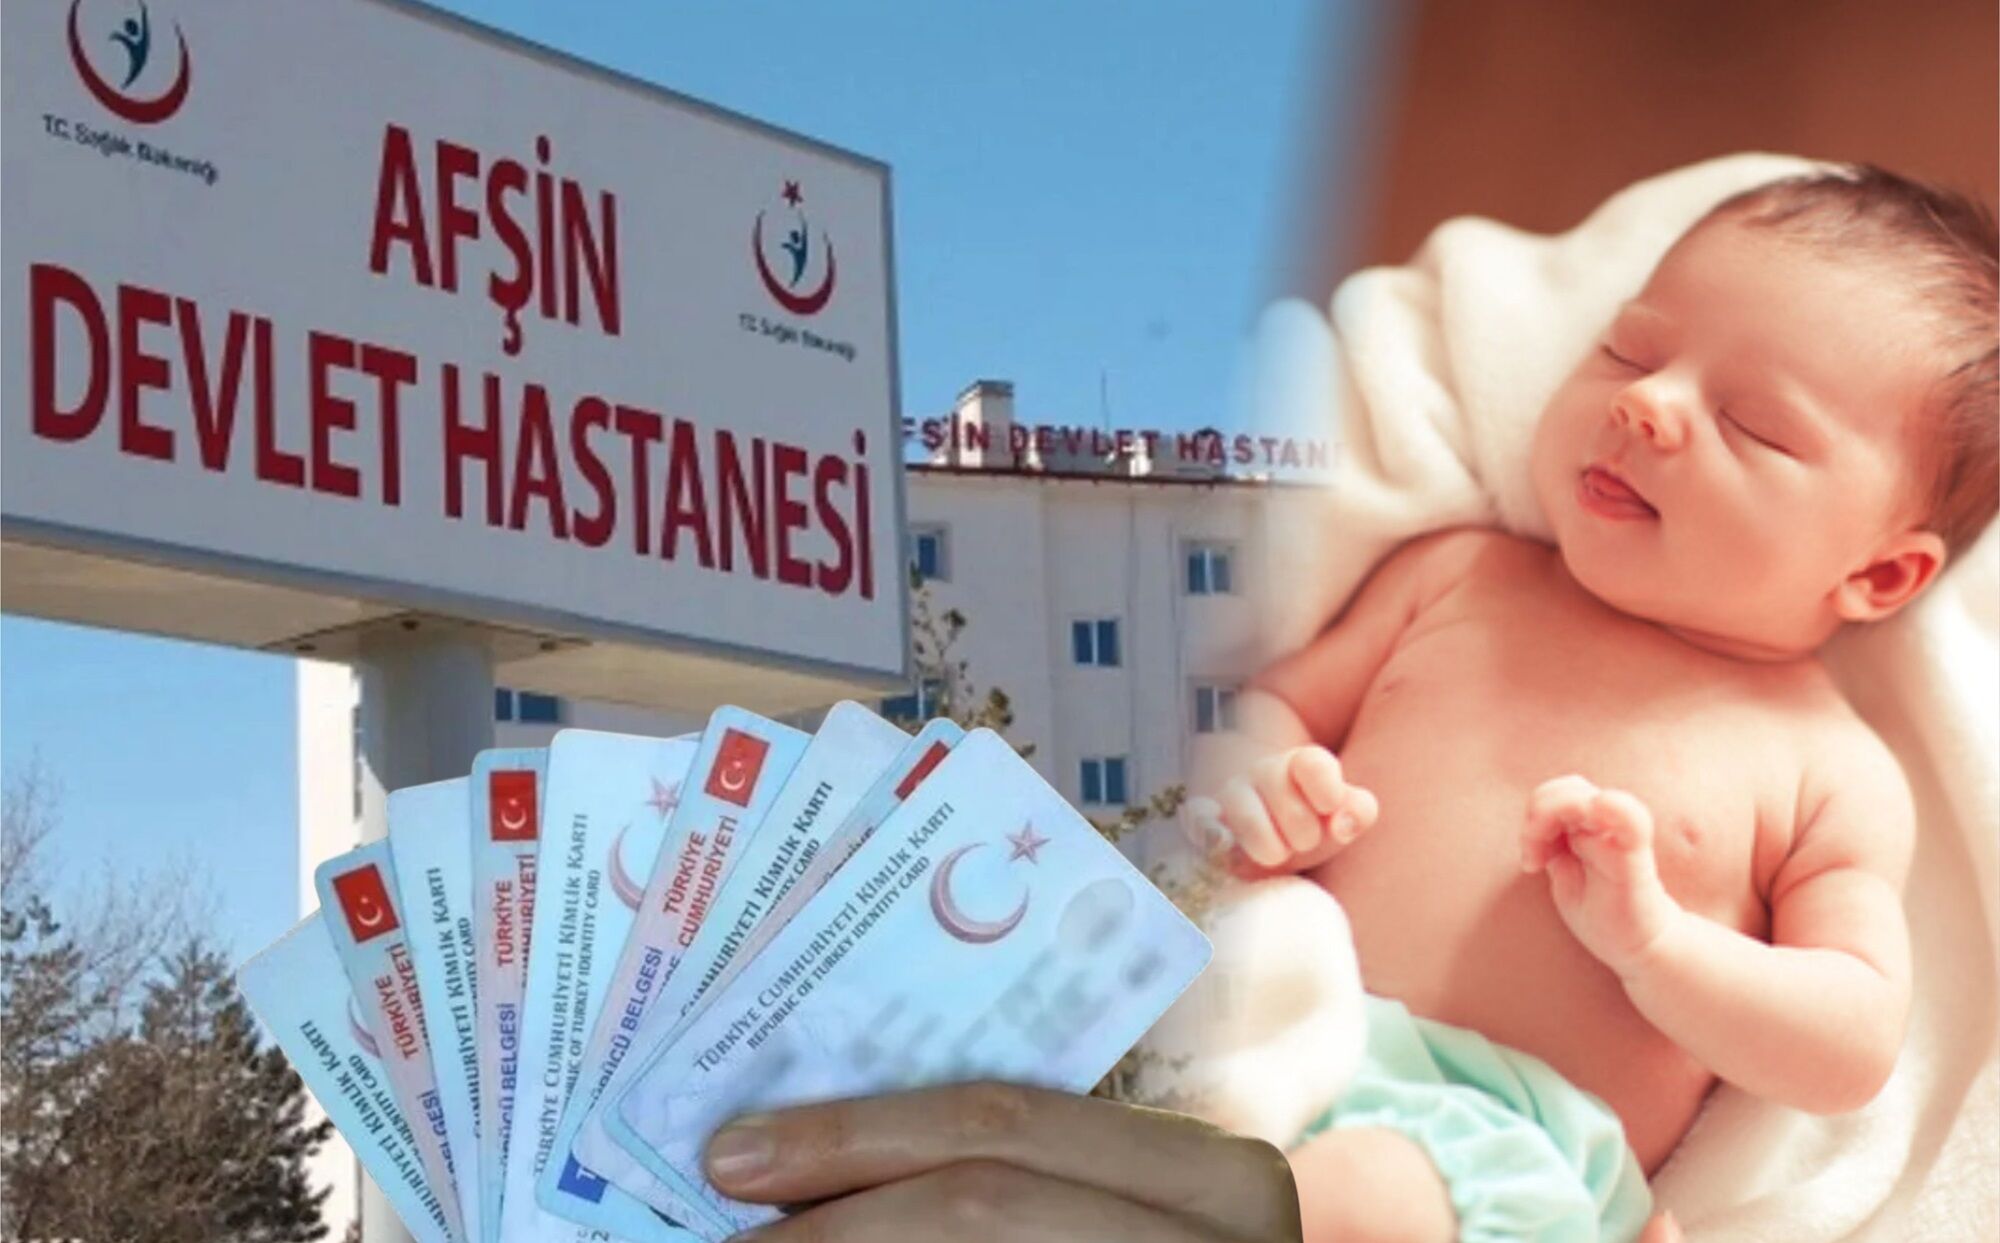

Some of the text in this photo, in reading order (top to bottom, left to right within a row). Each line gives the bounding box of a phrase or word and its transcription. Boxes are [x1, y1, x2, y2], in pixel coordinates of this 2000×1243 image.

[369, 123, 621, 356] AFŞİN
[29, 263, 876, 600] DEVLET HASTANESİ
[1009, 421, 1160, 458] DEVLET
[662, 829, 707, 917] TÜRKİYE
[677, 814, 739, 949] CUMHURİYETİ
[754, 835, 803, 900] KİMLİK
[793, 781, 834, 835] KARTI
[793, 838, 820, 877] CARD
[426, 867, 450, 924] KARTI
[493, 879, 515, 968] TÜRKİYE
[584, 869, 601, 909] CARD
[543, 951, 574, 1087] CUMHURİYETİ
[567, 813, 588, 870] KARTI
[693, 1006, 762, 1073] TÜRKİYE
[757, 902, 859, 1009] CUMHURİYETİ
[855, 847, 912, 905] KİMLİK
[907, 802, 955, 850] KARTI
[746, 998, 801, 1051] REPUBLIC
[799, 977, 815, 998] OF
[813, 938, 855, 981] TURKEY
[855, 890, 901, 941] IDENTITY
[900, 855, 931, 891] CARD
[375, 974, 419, 1060] TÜRKİYE
[620, 945, 664, 1034] BELGESİ
[300, 1020, 341, 1072] KARTI
[349, 1054, 378, 1090] CARD
[496, 1002, 518, 1090] BELGESİ
